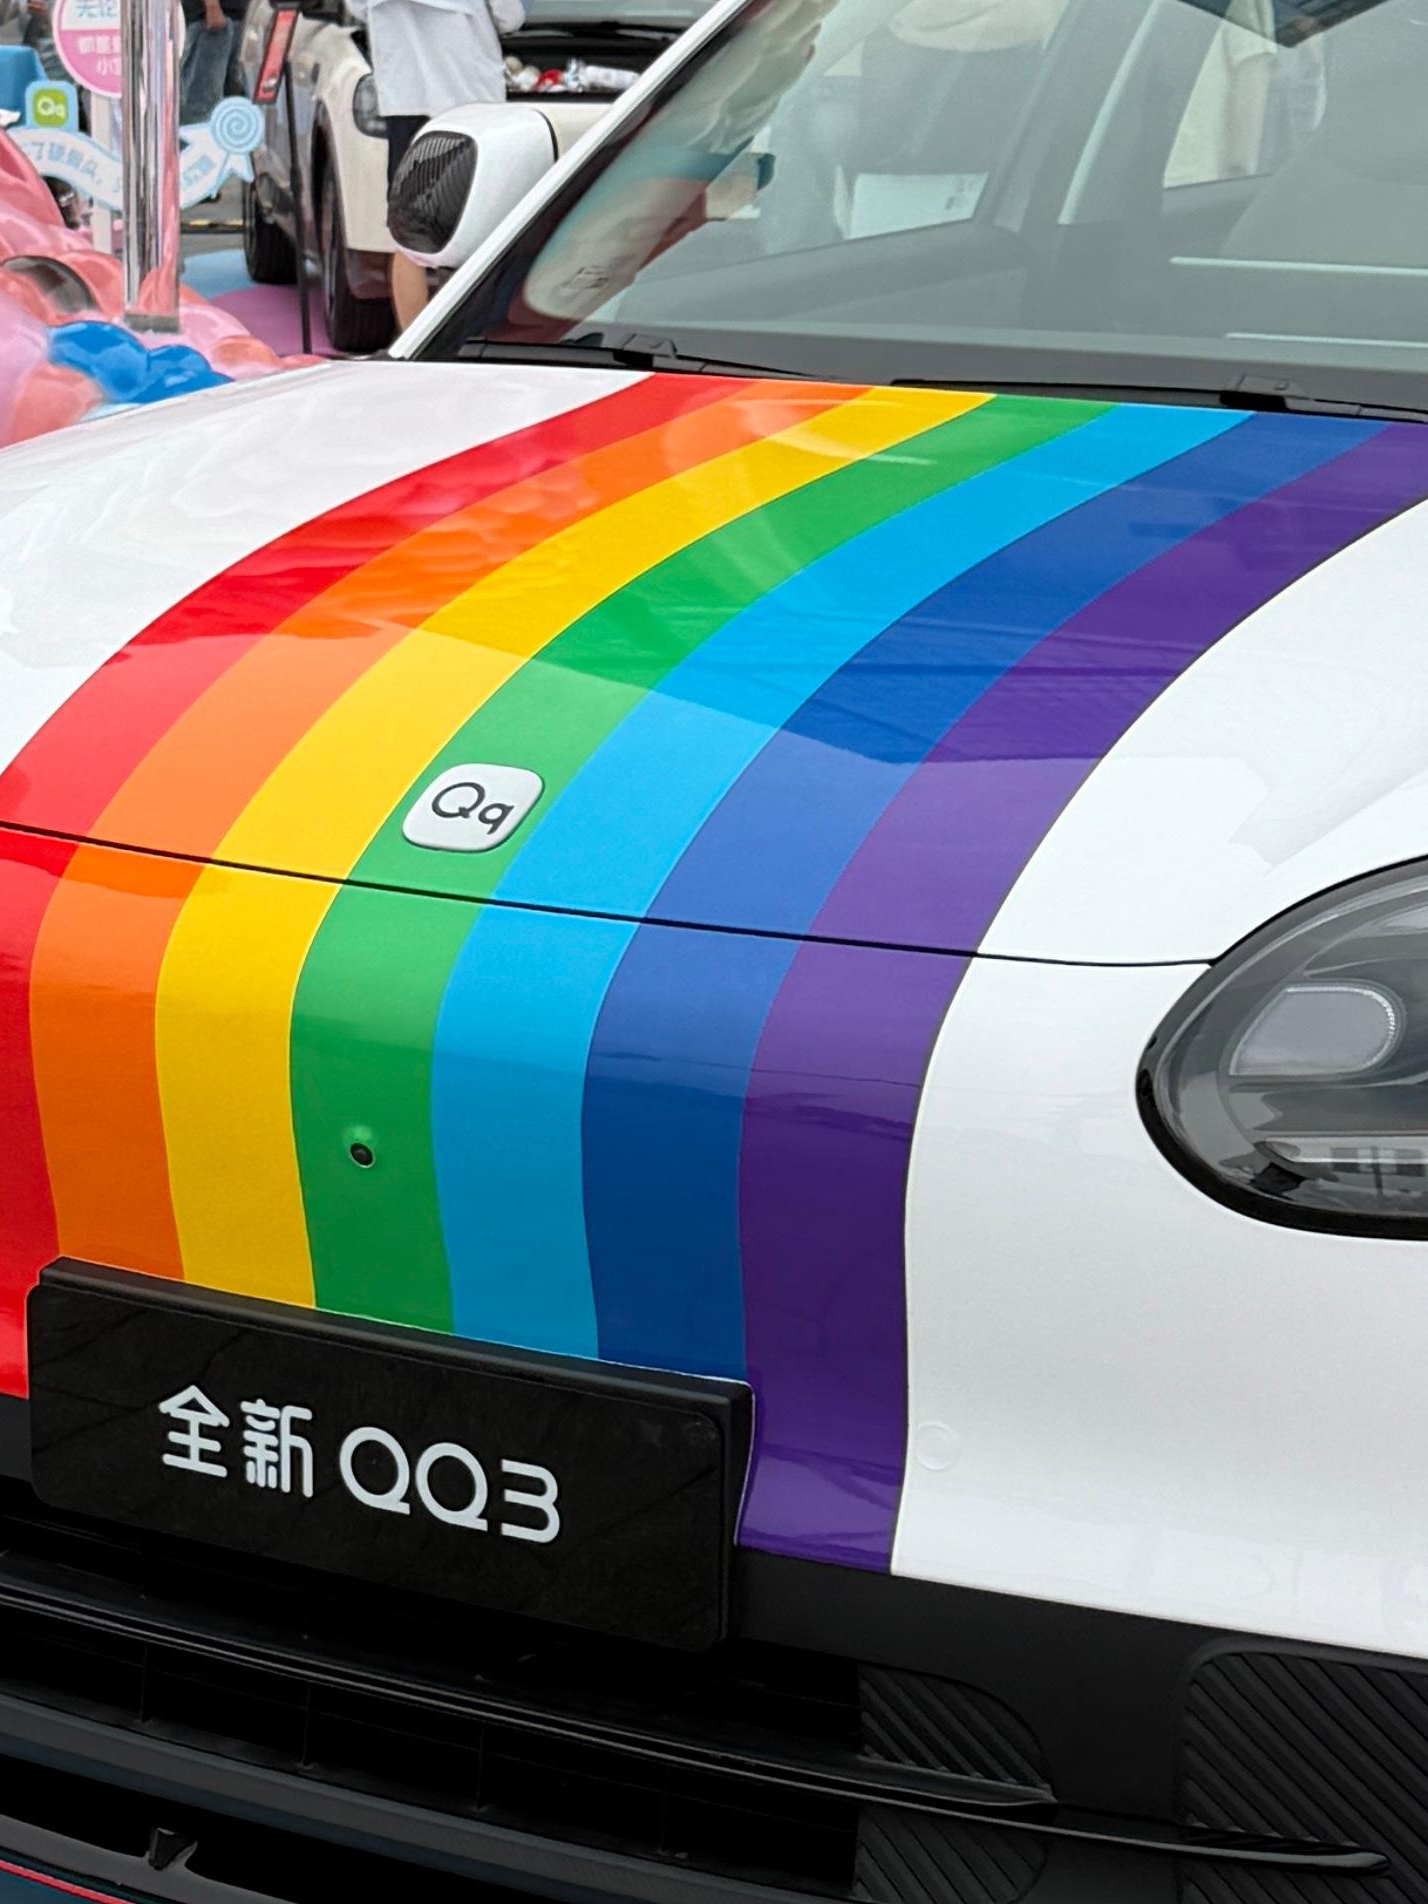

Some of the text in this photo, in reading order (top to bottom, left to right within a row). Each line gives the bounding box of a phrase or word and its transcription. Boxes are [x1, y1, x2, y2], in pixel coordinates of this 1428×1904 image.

[431, 781, 516, 836] Qq
[158, 1384, 561, 1545] 全新 QQ3
